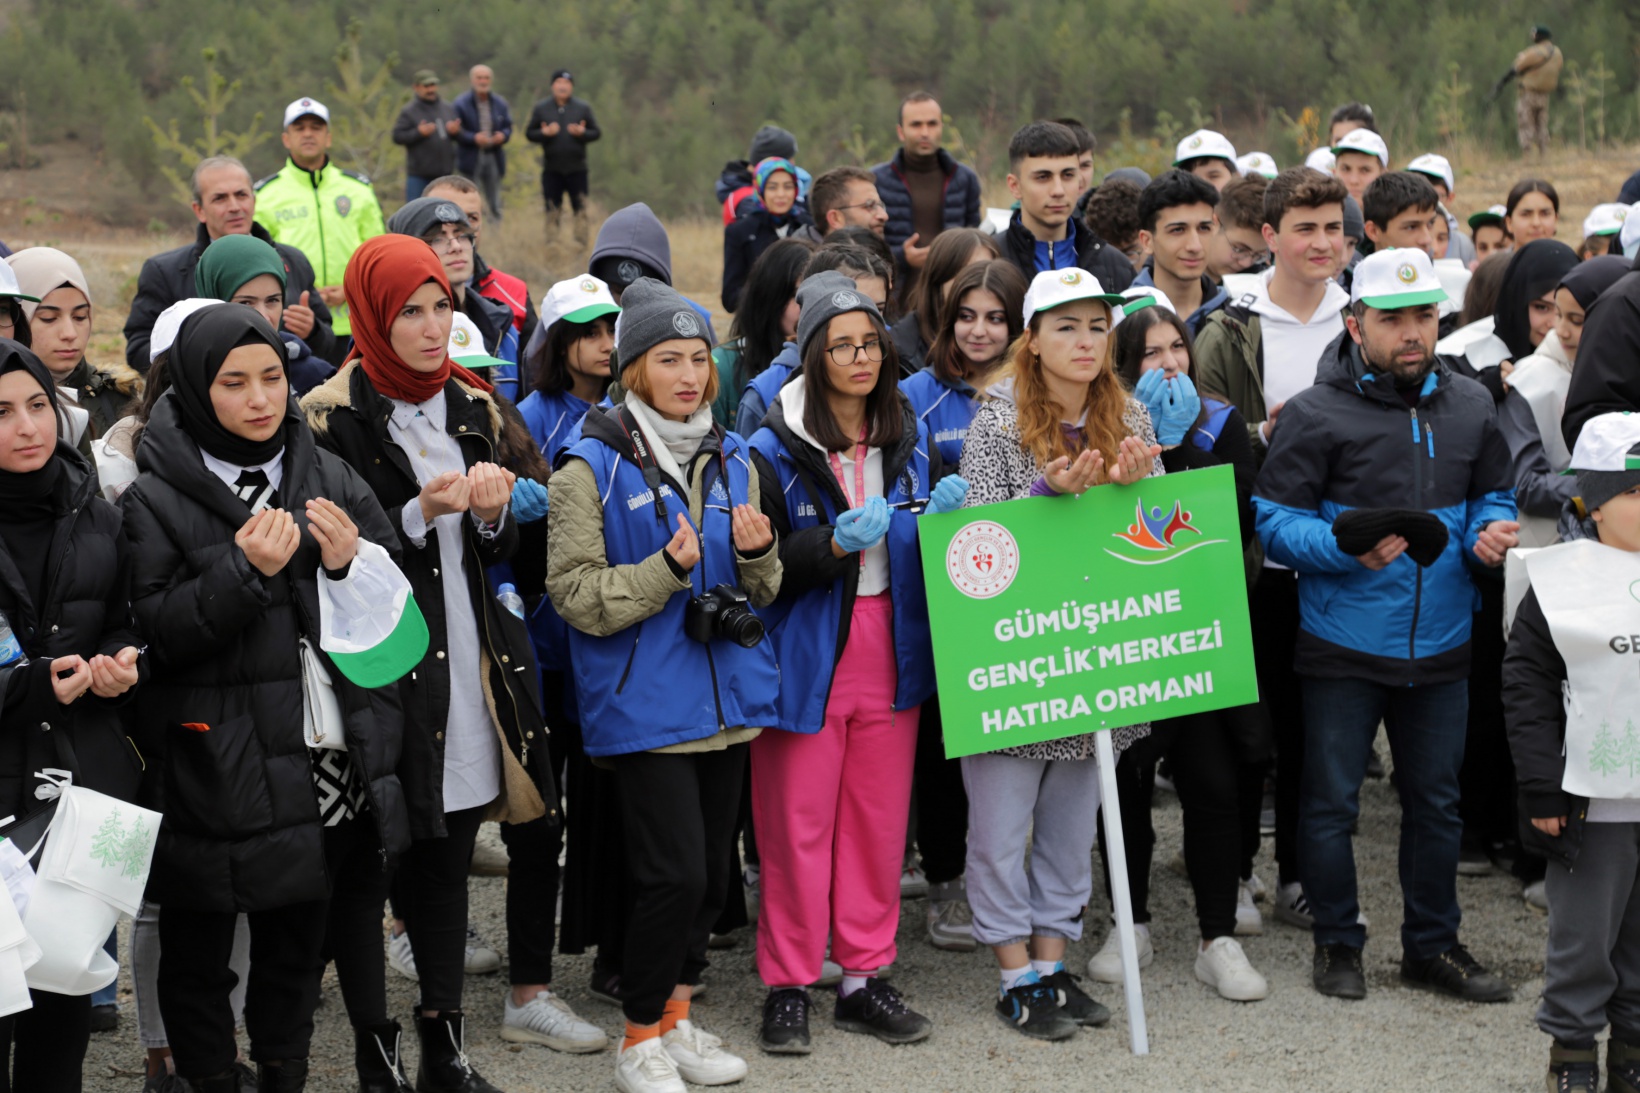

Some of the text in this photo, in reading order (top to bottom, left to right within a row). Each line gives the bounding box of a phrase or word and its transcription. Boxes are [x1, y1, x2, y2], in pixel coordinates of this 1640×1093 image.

[631, 430, 647, 458] Canon
[995, 590, 1182, 642] GÜMÜŞHANE
[968, 620, 1223, 691] GENÇLİK MERKEZİ
[981, 671, 1214, 734] HATIRA ORMANI
